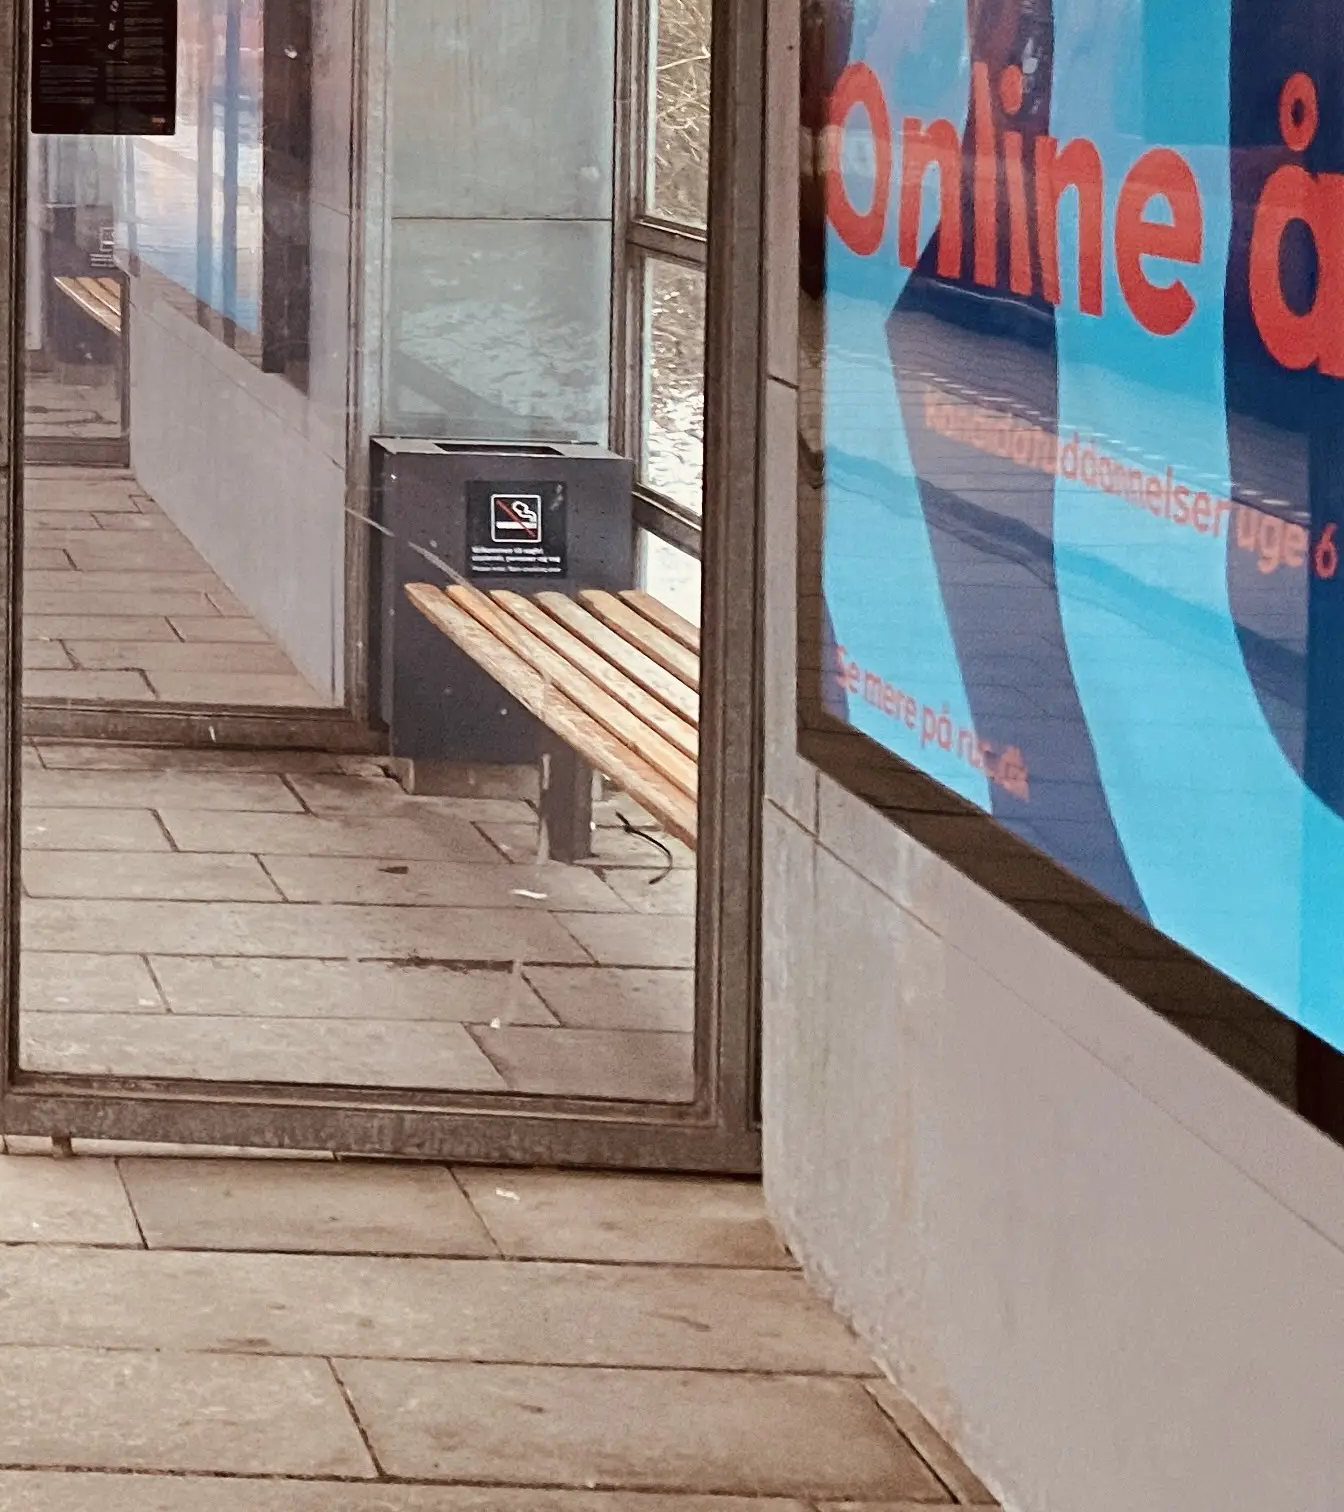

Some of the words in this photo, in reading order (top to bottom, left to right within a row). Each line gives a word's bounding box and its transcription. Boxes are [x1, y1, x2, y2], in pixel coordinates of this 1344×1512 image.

[826, 61, 1204, 336] Online
[1236, 504, 1307, 575] uge
[1314, 521, 1338, 580] 6
[865, 671, 917, 730] mere
[921, 700, 953, 751] på
